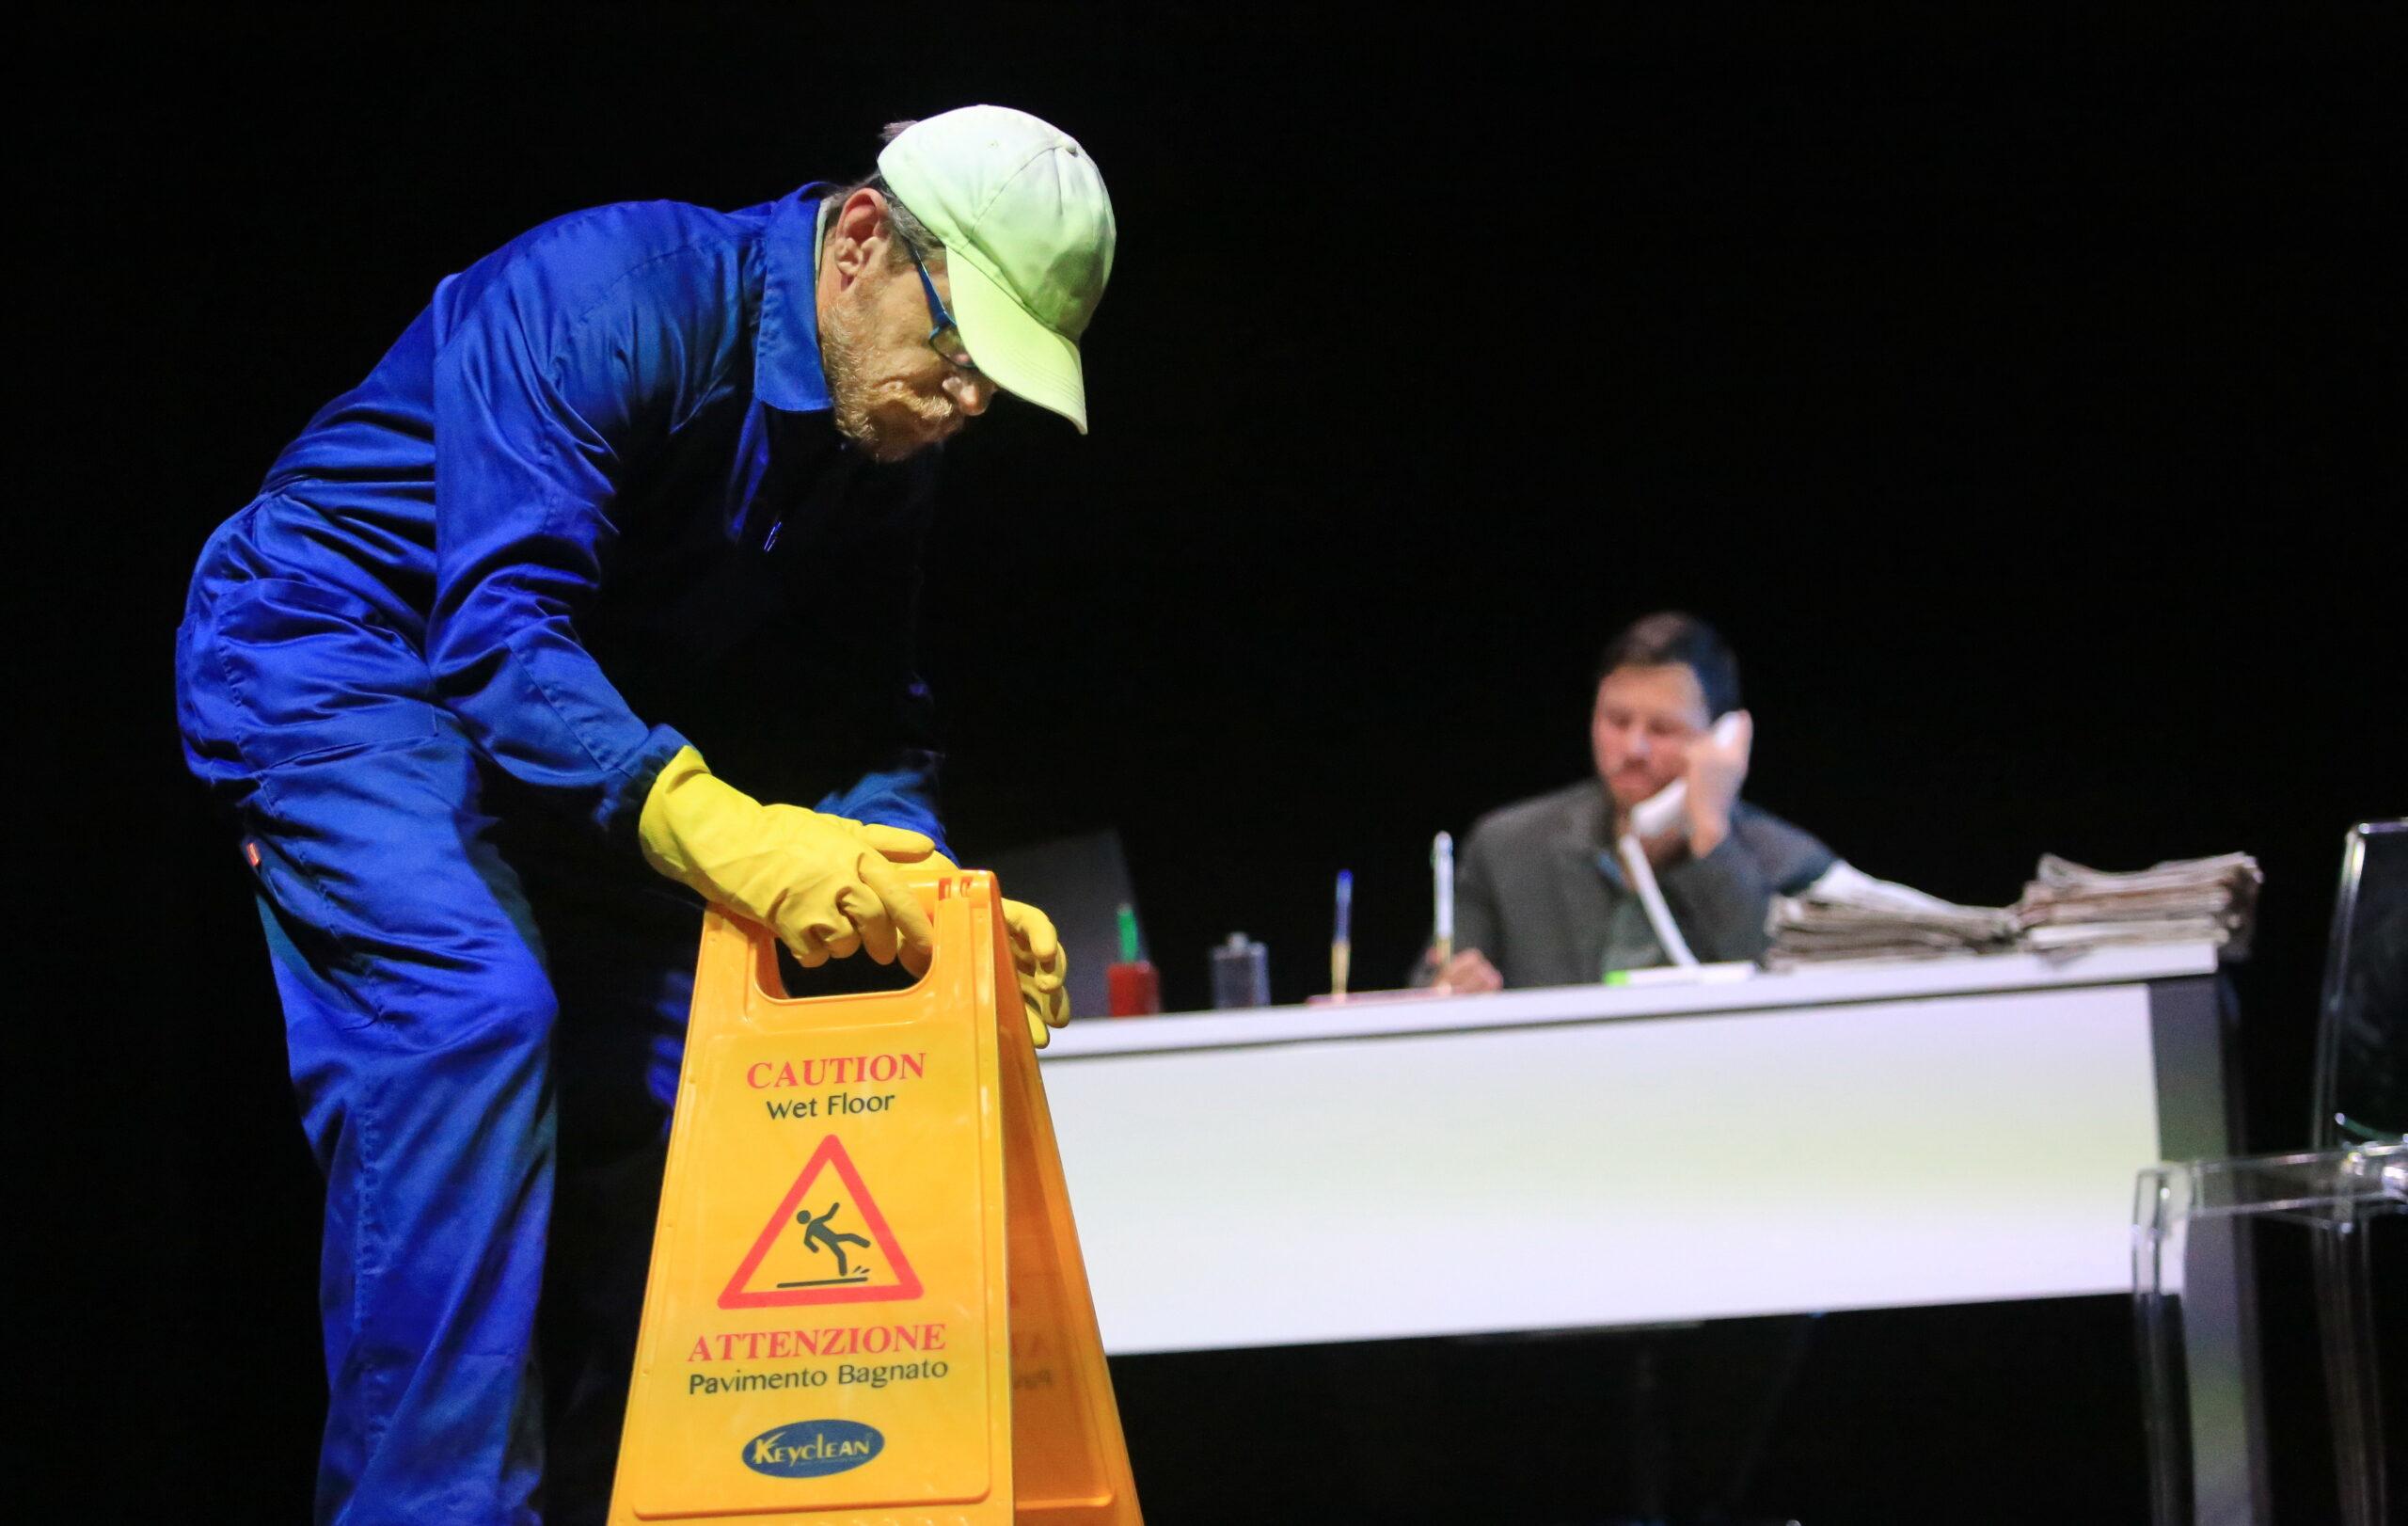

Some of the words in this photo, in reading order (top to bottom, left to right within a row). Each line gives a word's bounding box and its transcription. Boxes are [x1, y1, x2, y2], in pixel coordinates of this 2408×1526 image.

[747, 1053, 927, 1089] CAUTION
[767, 1098, 817, 1121] Wet
[828, 1092, 895, 1116] Floor
[688, 1324, 946, 1362] ATTENZIONE
[689, 1368, 828, 1394] Pavimento
[838, 1359, 949, 1389] Bagnato
